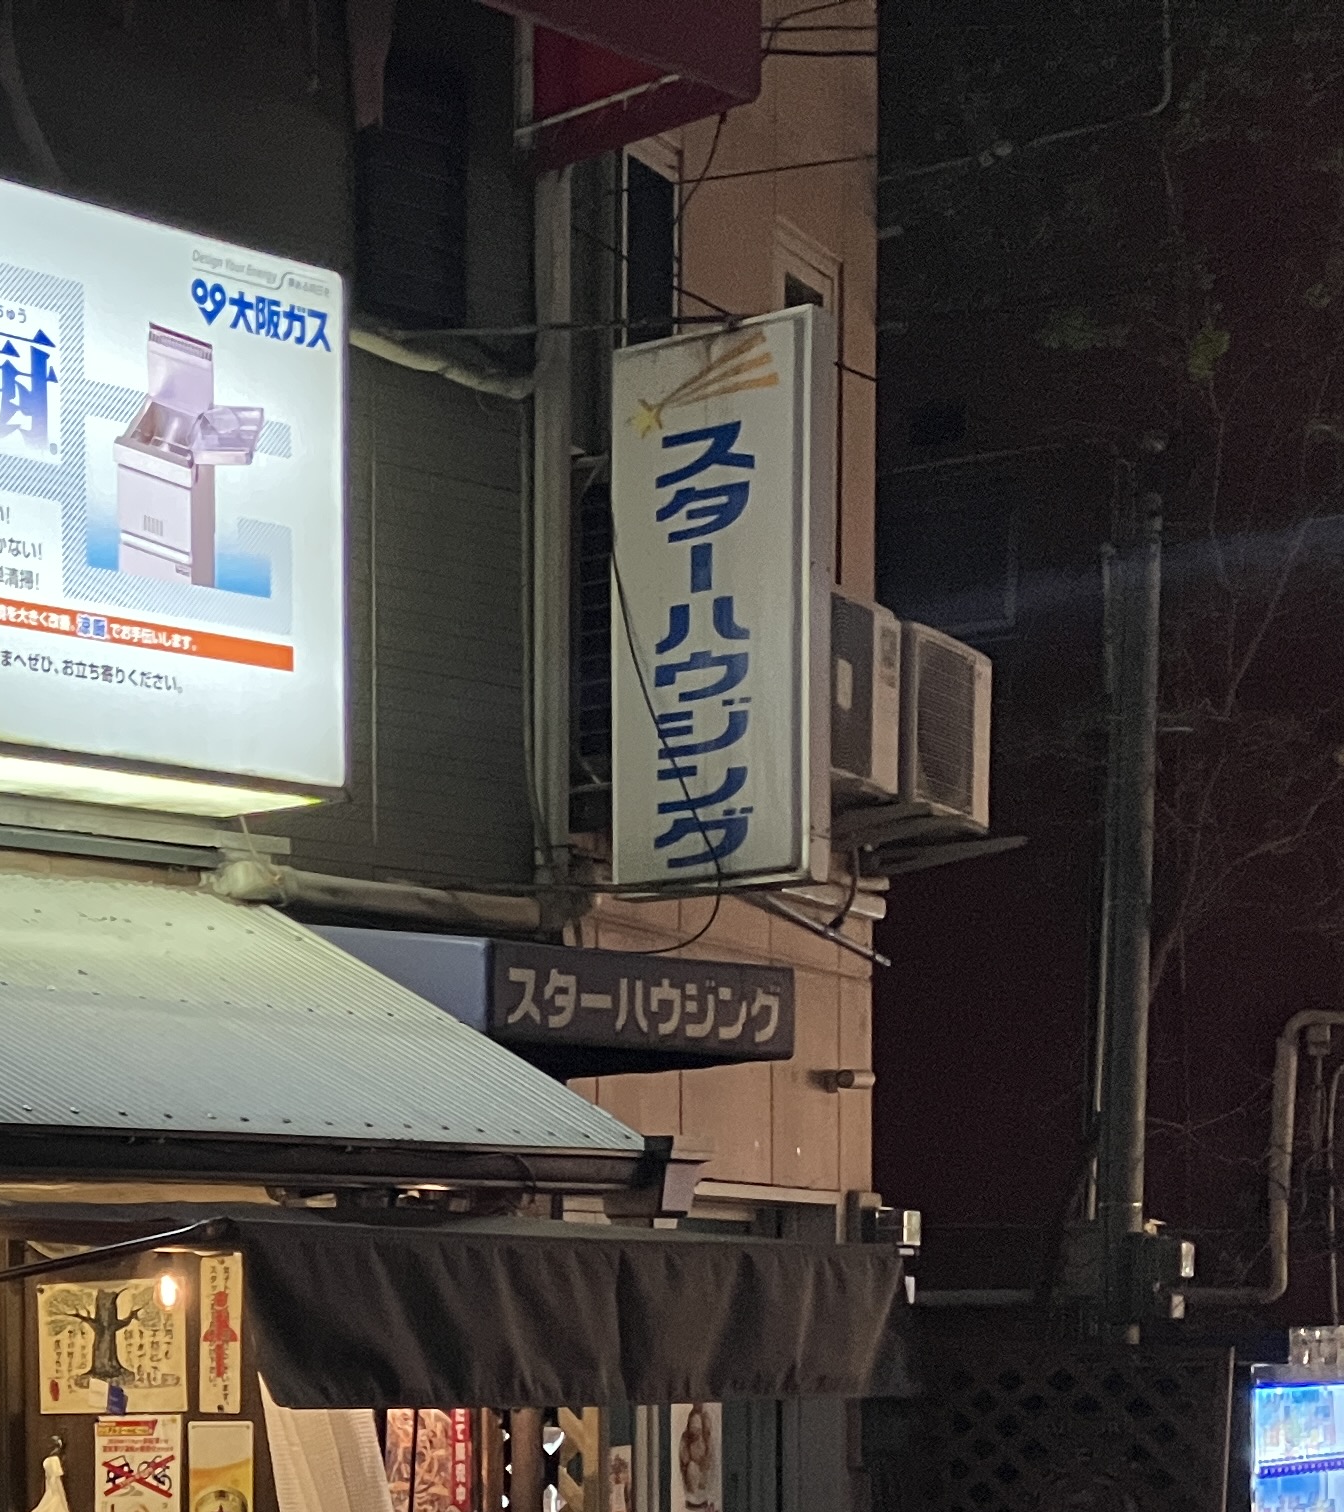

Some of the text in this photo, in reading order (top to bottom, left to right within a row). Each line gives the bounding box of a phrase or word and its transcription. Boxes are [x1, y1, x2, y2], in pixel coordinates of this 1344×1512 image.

[228, 290, 332, 353] 大阪ガス
[654, 419, 756, 869] スターハウジング
[506, 965, 782, 1045] スターハウジング
